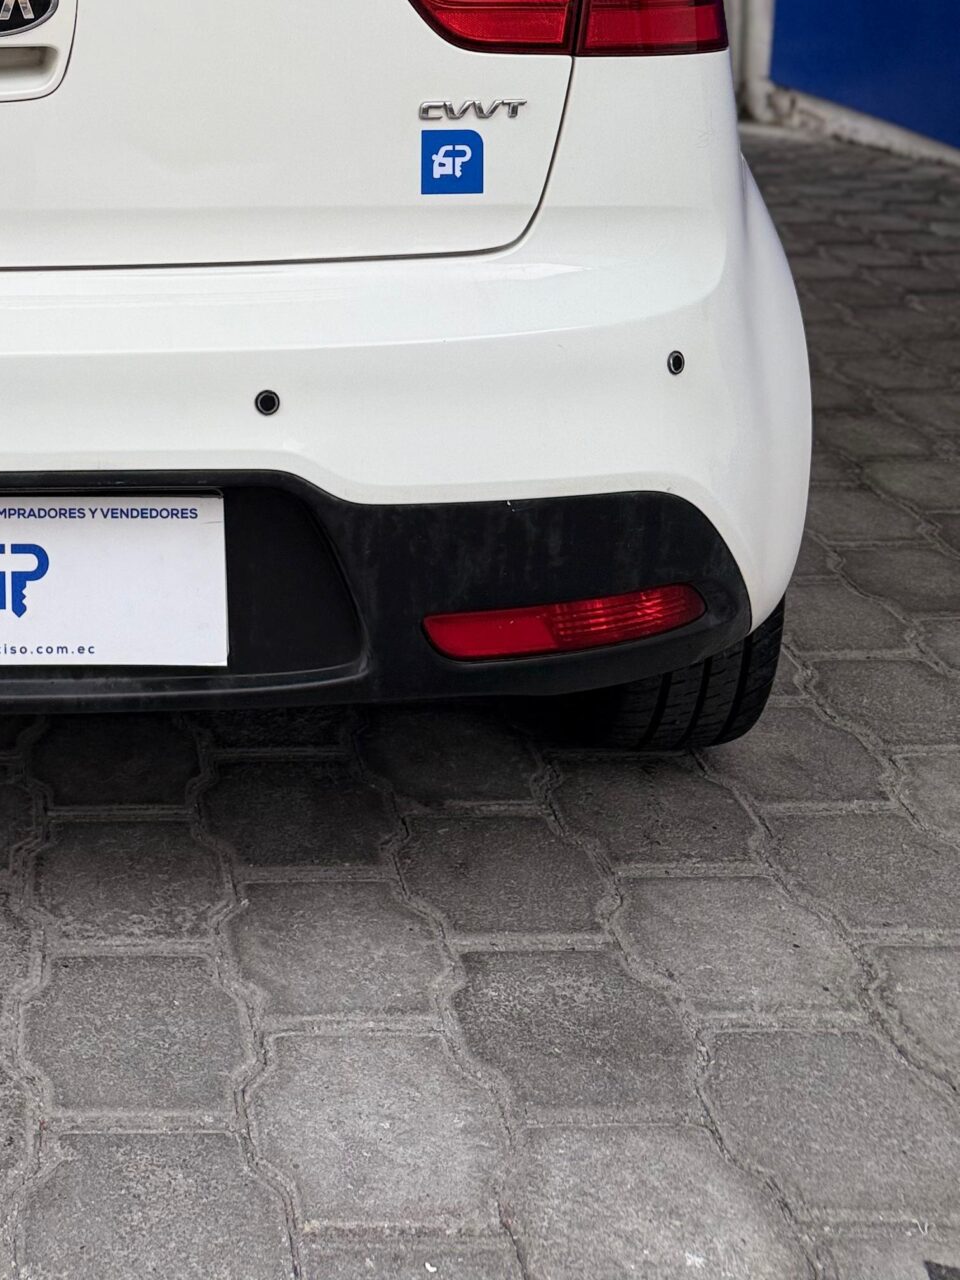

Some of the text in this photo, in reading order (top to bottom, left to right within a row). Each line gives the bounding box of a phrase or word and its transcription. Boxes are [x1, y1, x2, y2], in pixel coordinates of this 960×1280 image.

[418, 99, 528, 121] CVVT
[87, 507, 99, 519] Y
[100, 507, 199, 520] VENDEDORES
